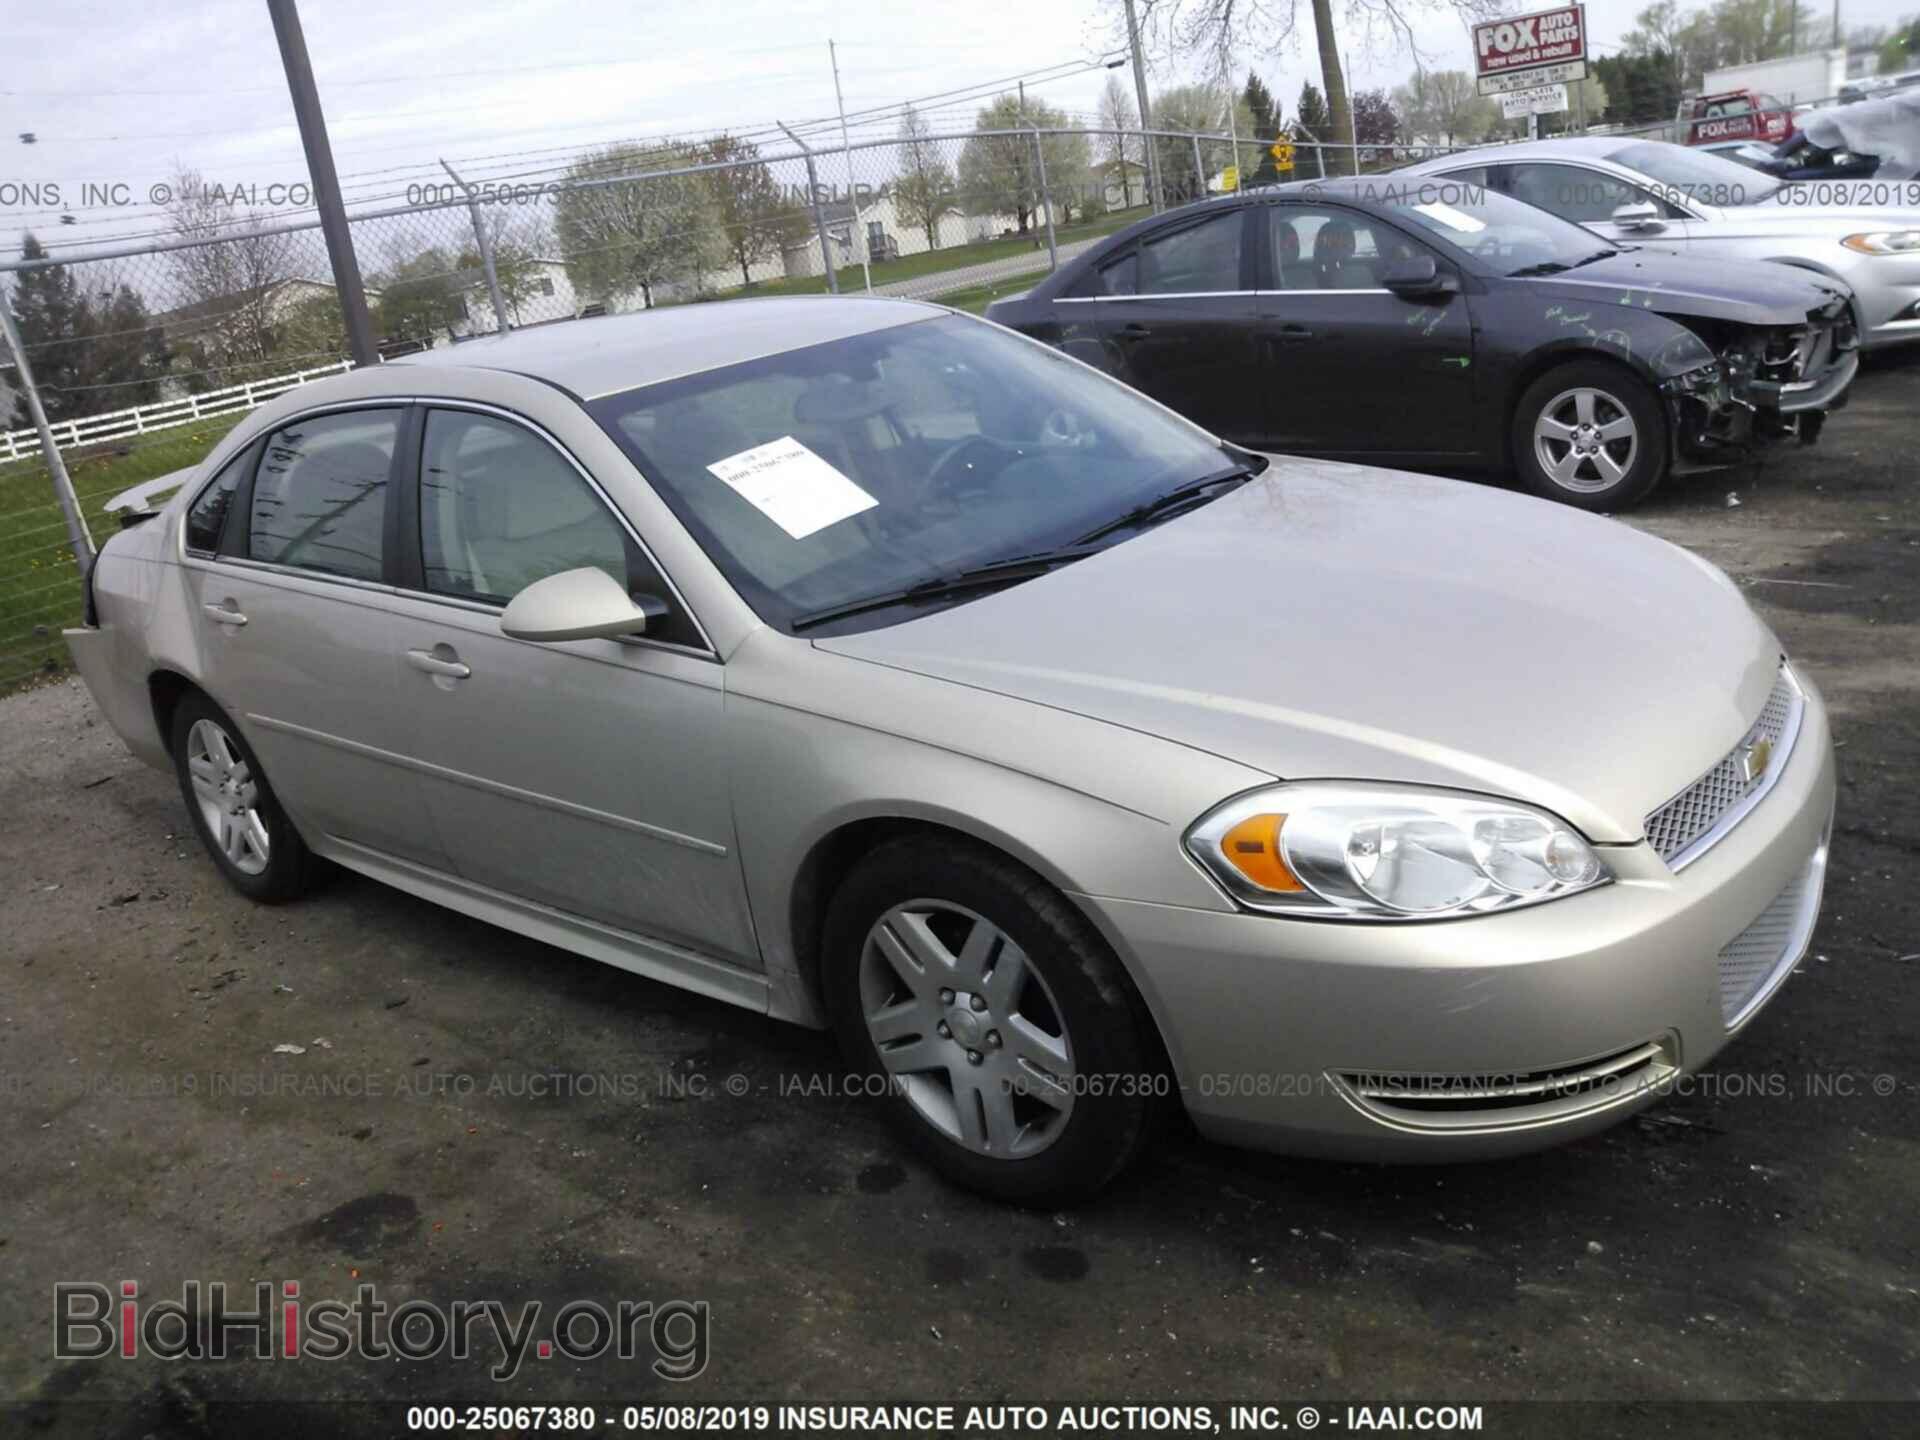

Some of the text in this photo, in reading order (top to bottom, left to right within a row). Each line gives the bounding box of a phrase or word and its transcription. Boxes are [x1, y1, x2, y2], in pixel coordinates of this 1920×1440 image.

[1539, 12, 1573, 31] AUTO
[1478, 19, 1538, 56] FOX
[1540, 25, 1578, 45] PARTS
[1508, 50, 1531, 64] used
[1505, 97, 1527, 106] AUTO
[1511, 87, 1554, 98] COMLETE
[1698, 119, 1728, 138] FOX
